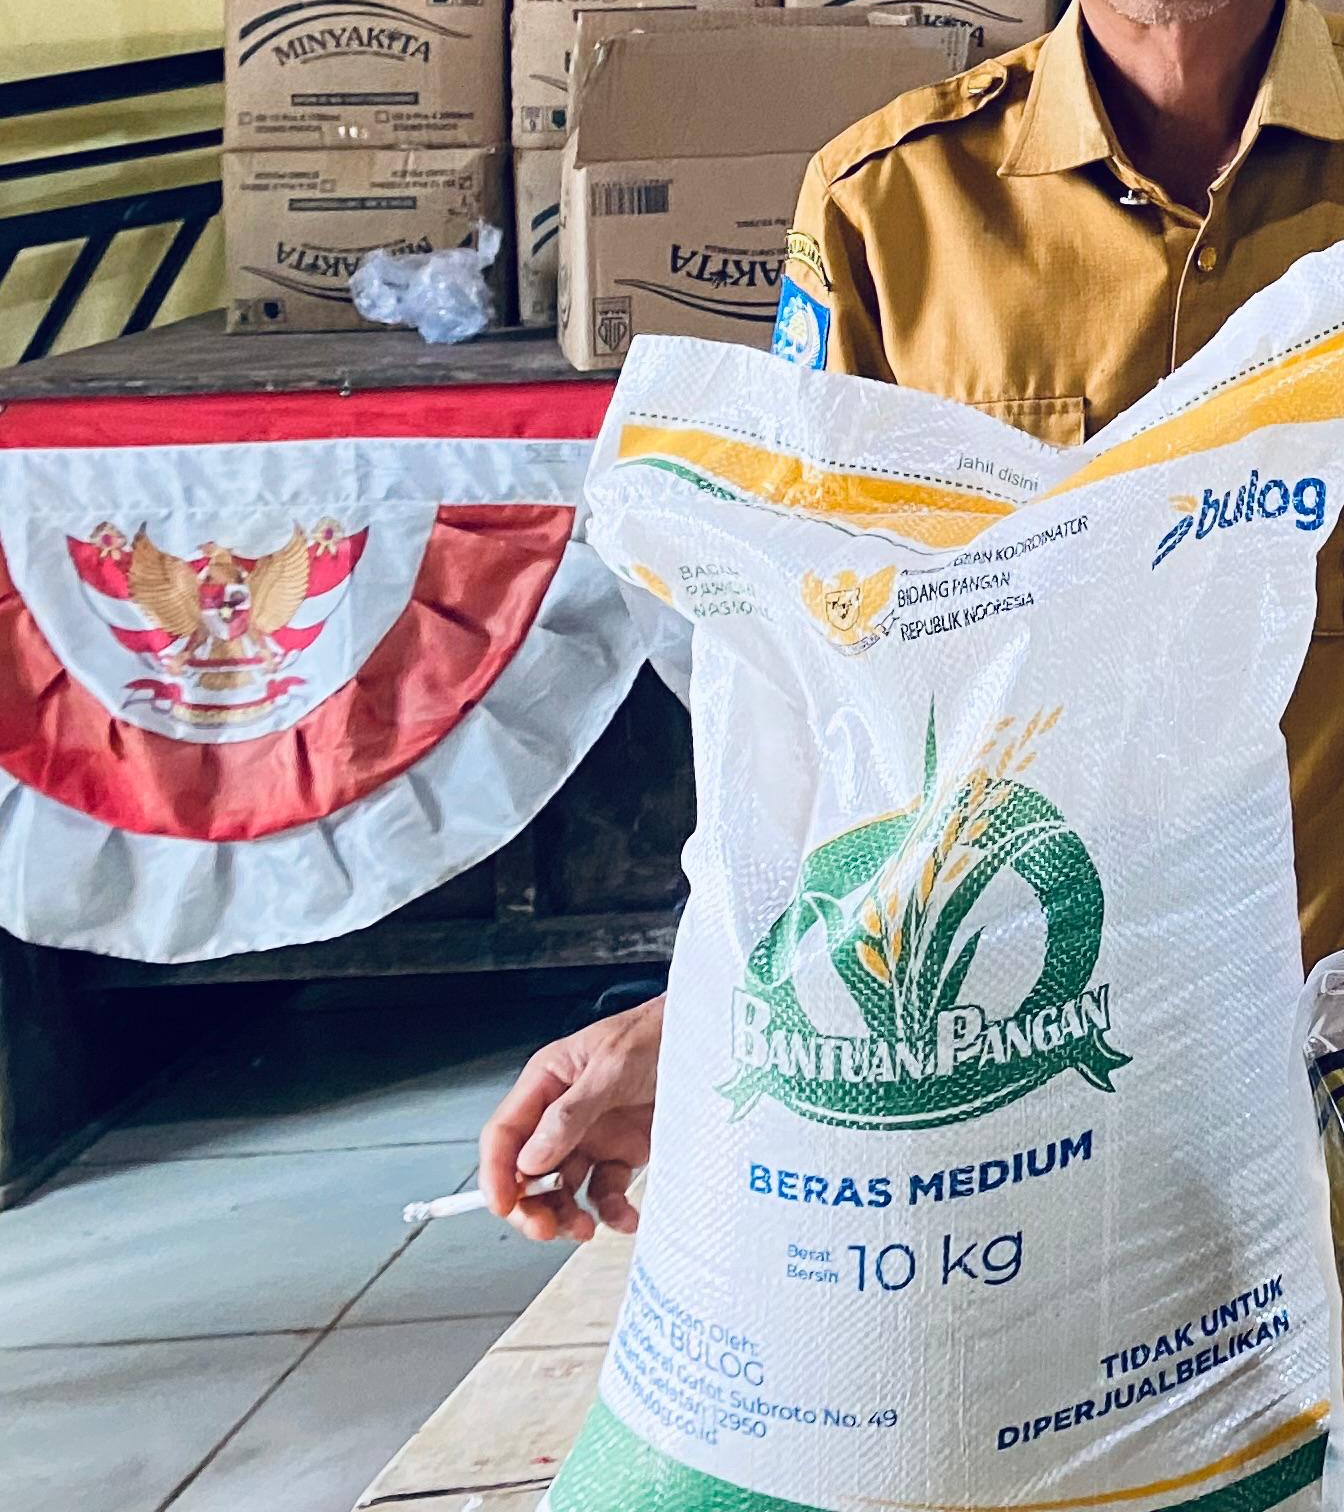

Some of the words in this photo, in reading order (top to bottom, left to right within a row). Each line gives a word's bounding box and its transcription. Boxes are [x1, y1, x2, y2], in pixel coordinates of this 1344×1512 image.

[272, 26, 431, 67] MINYAKITA
[998, 468, 1039, 491] disini
[1194, 468, 1326, 541] bulog
[898, 581, 950, 608] BIDANG
[952, 572, 1011, 598] PANGAN
[900, 611, 961, 641] REPUBLIK
[963, 593, 1035, 628] INDONESIA
[732, 986, 925, 1083] BANTUAN
[928, 985, 1111, 1079] PANGAN
[749, 1161, 892, 1208] BERAS
[909, 1129, 1094, 1206] MEDIUM
[848, 1243, 916, 1291] 10
[942, 1230, 1024, 1286] kg
[670, 1323, 764, 1386] BULOG
[1101, 1322, 1194, 1379] TIDAK
[1201, 1274, 1283, 1337] UNTUK
[730, 1390, 817, 1424] Subroto
[824, 1409, 861, 1428] No.
[868, 1409, 897, 1428] 49
[997, 1309, 1289, 1450] DIPERJUALBELIKAN
